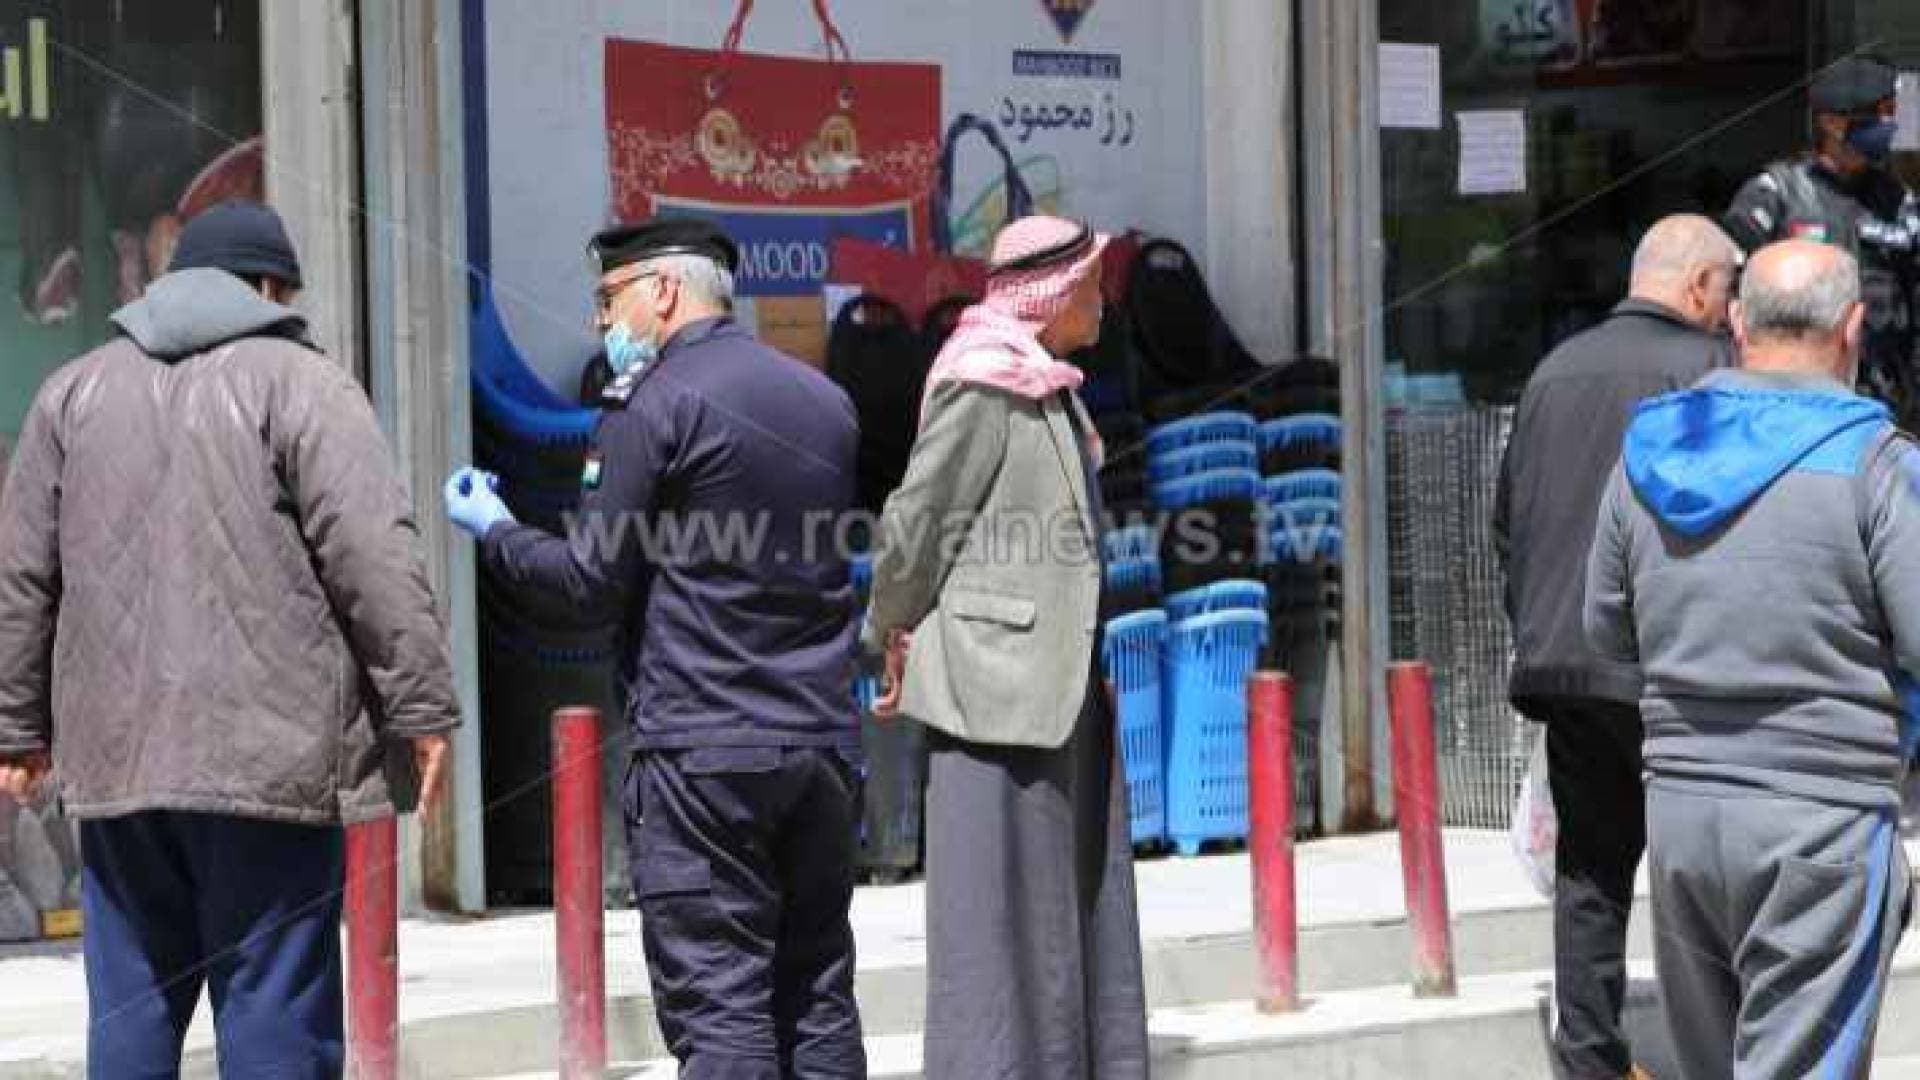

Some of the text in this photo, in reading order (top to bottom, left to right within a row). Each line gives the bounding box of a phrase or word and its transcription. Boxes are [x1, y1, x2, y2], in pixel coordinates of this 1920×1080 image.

[1001, 92, 1135, 146] رز محمود
[736, 240, 829, 281] MOOD
